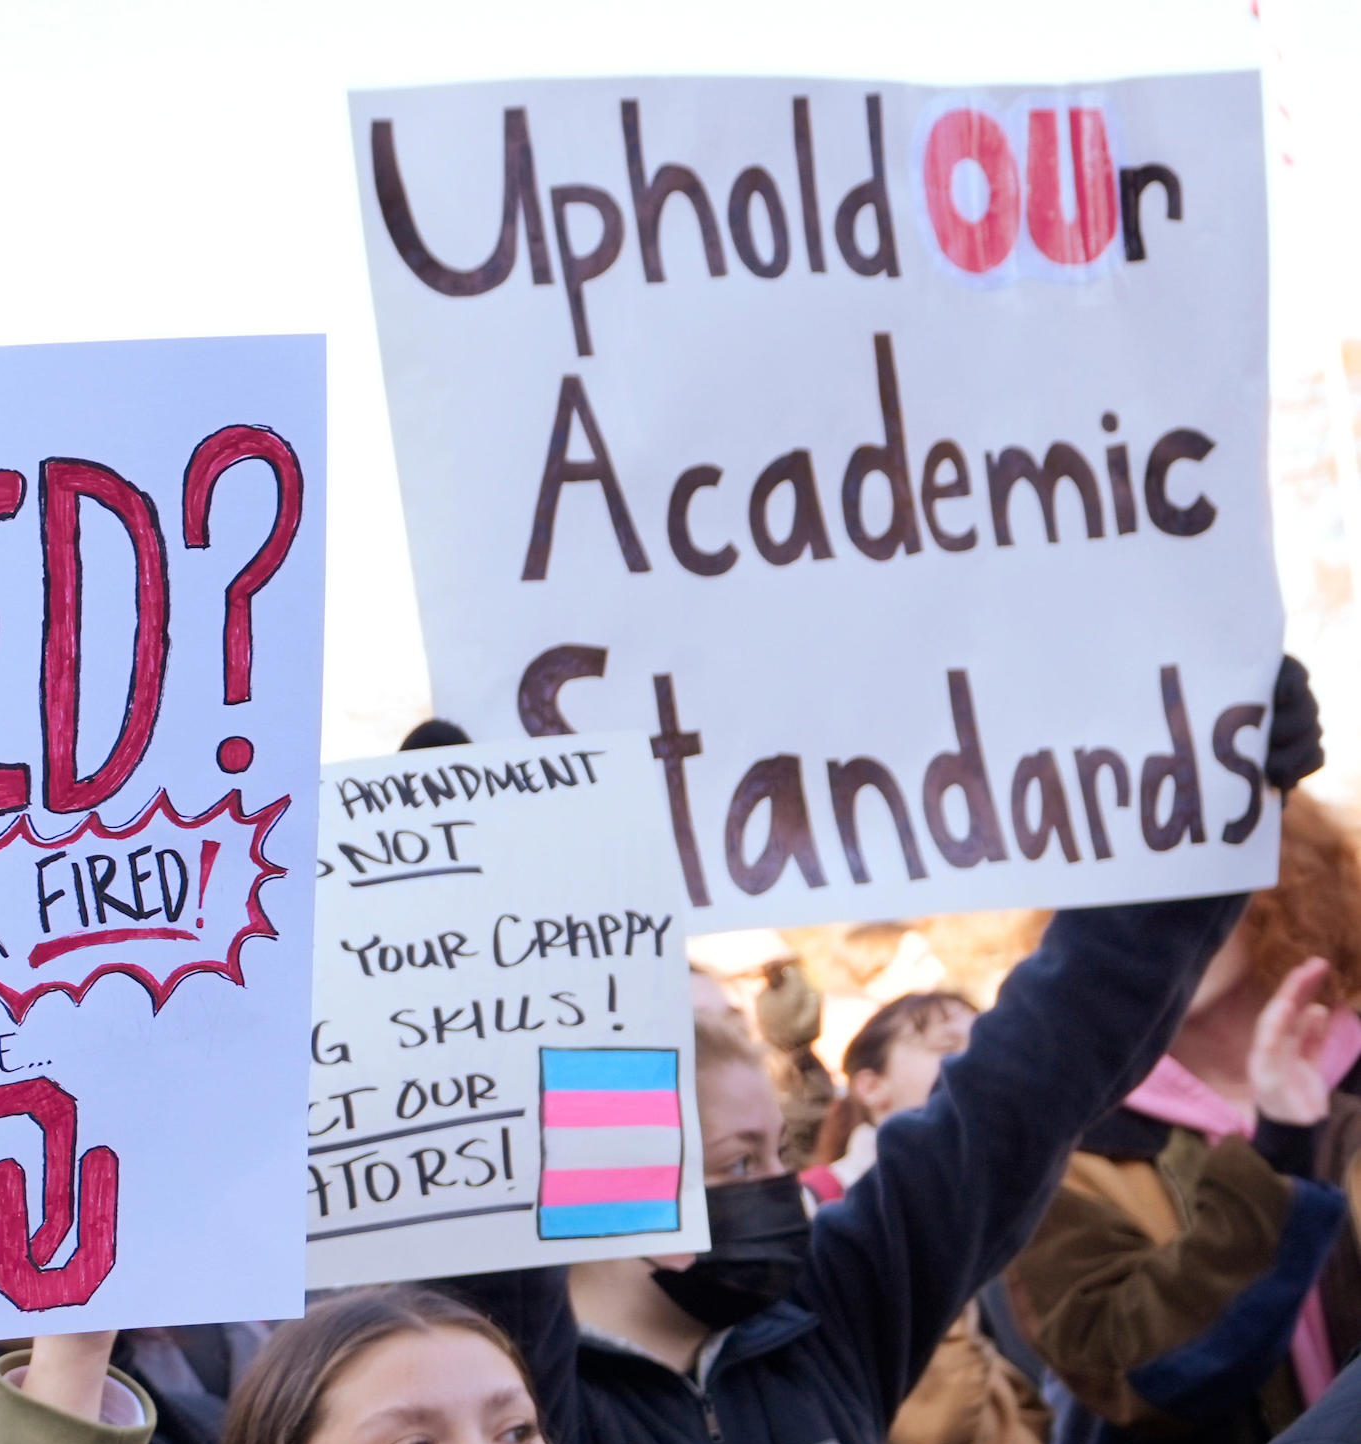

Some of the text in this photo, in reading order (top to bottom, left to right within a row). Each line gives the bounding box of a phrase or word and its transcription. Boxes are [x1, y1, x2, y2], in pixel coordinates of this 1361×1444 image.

[371, 93, 1185, 358] Uphold OUr
[521, 332, 1217, 583] Academic
[336, 751, 608, 820] AMENDMENT
[338, 821, 476, 874] NOT
[33, 838, 221, 930] FIRED!
[340, 910, 673, 978] YOUR CRAPPY
[389, 973, 625, 1049] SKILLS!
[397, 1074, 498, 1120] OUR
